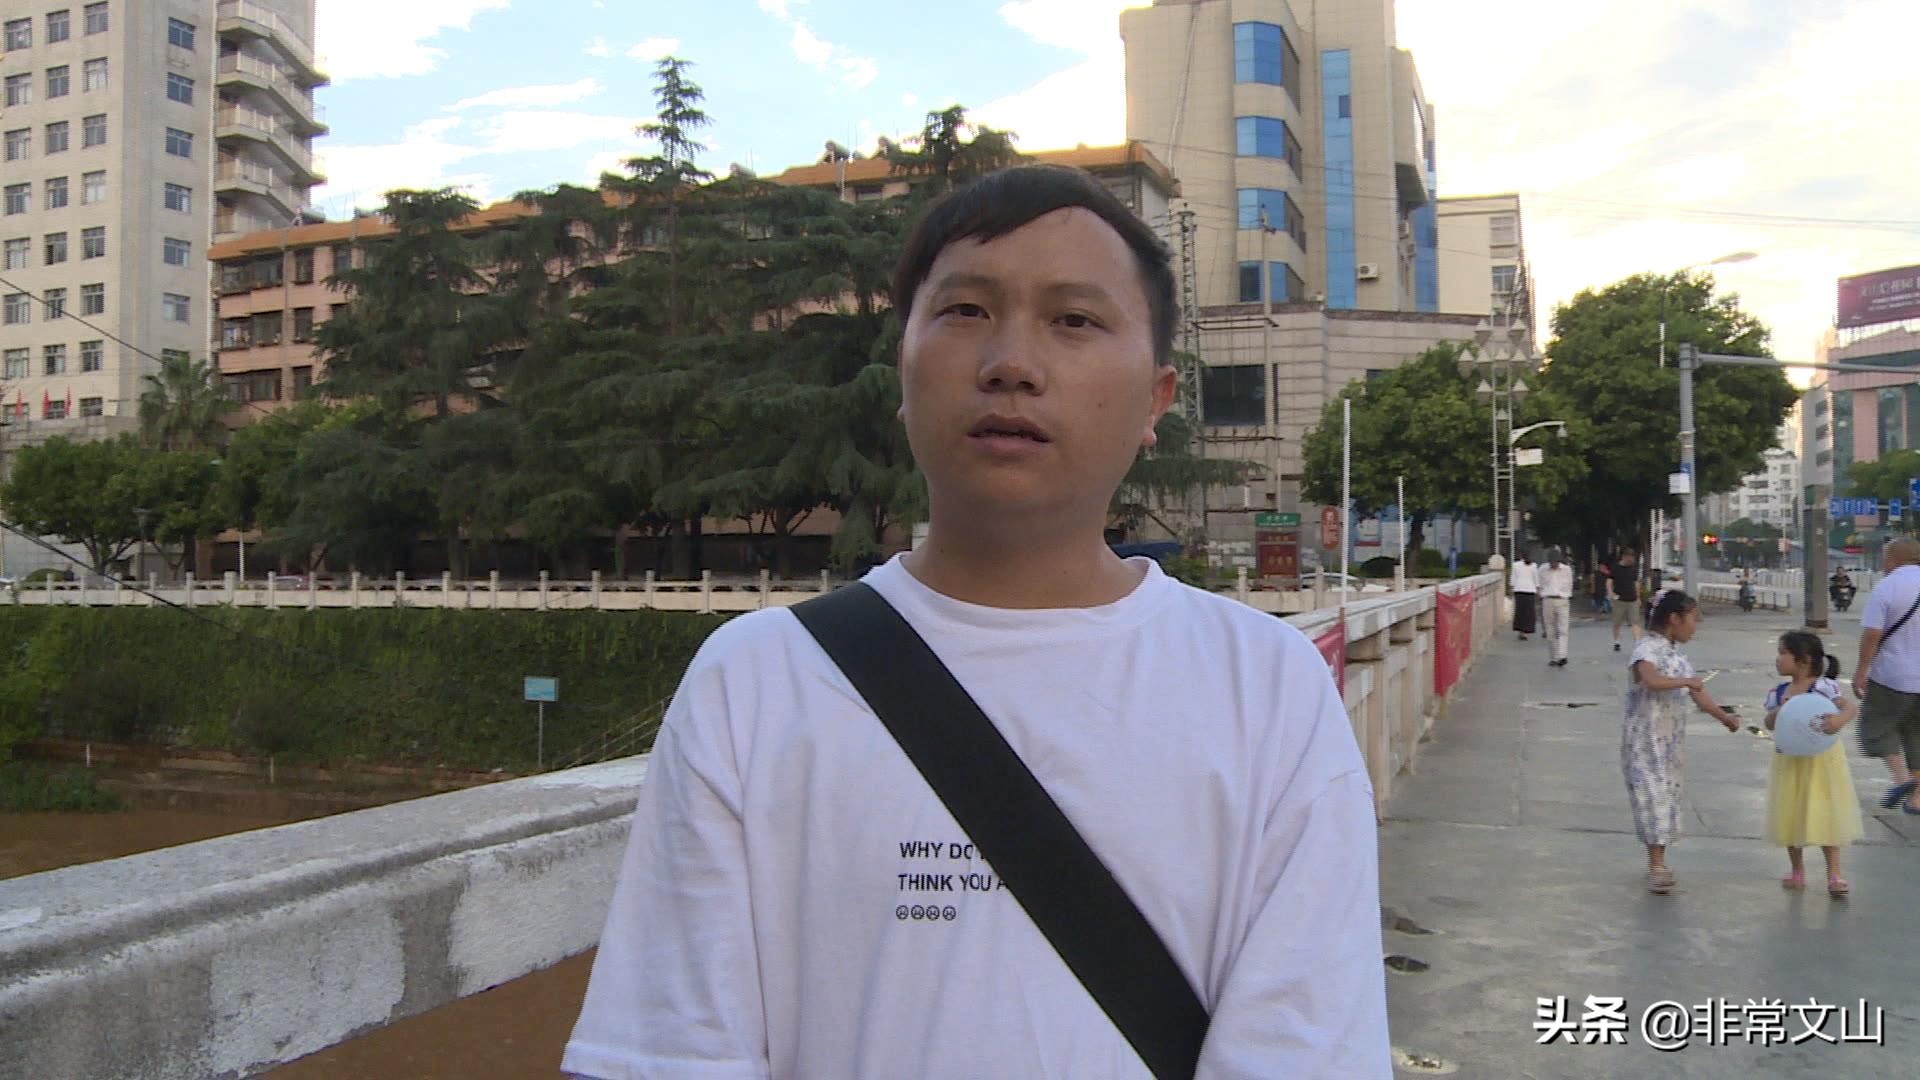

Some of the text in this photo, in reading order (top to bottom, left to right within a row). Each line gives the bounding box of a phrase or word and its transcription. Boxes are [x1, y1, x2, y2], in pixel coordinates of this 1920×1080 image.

[899, 841, 943, 858] WHY
[898, 873, 953, 892] THINK
[959, 873, 992, 892] YOU
